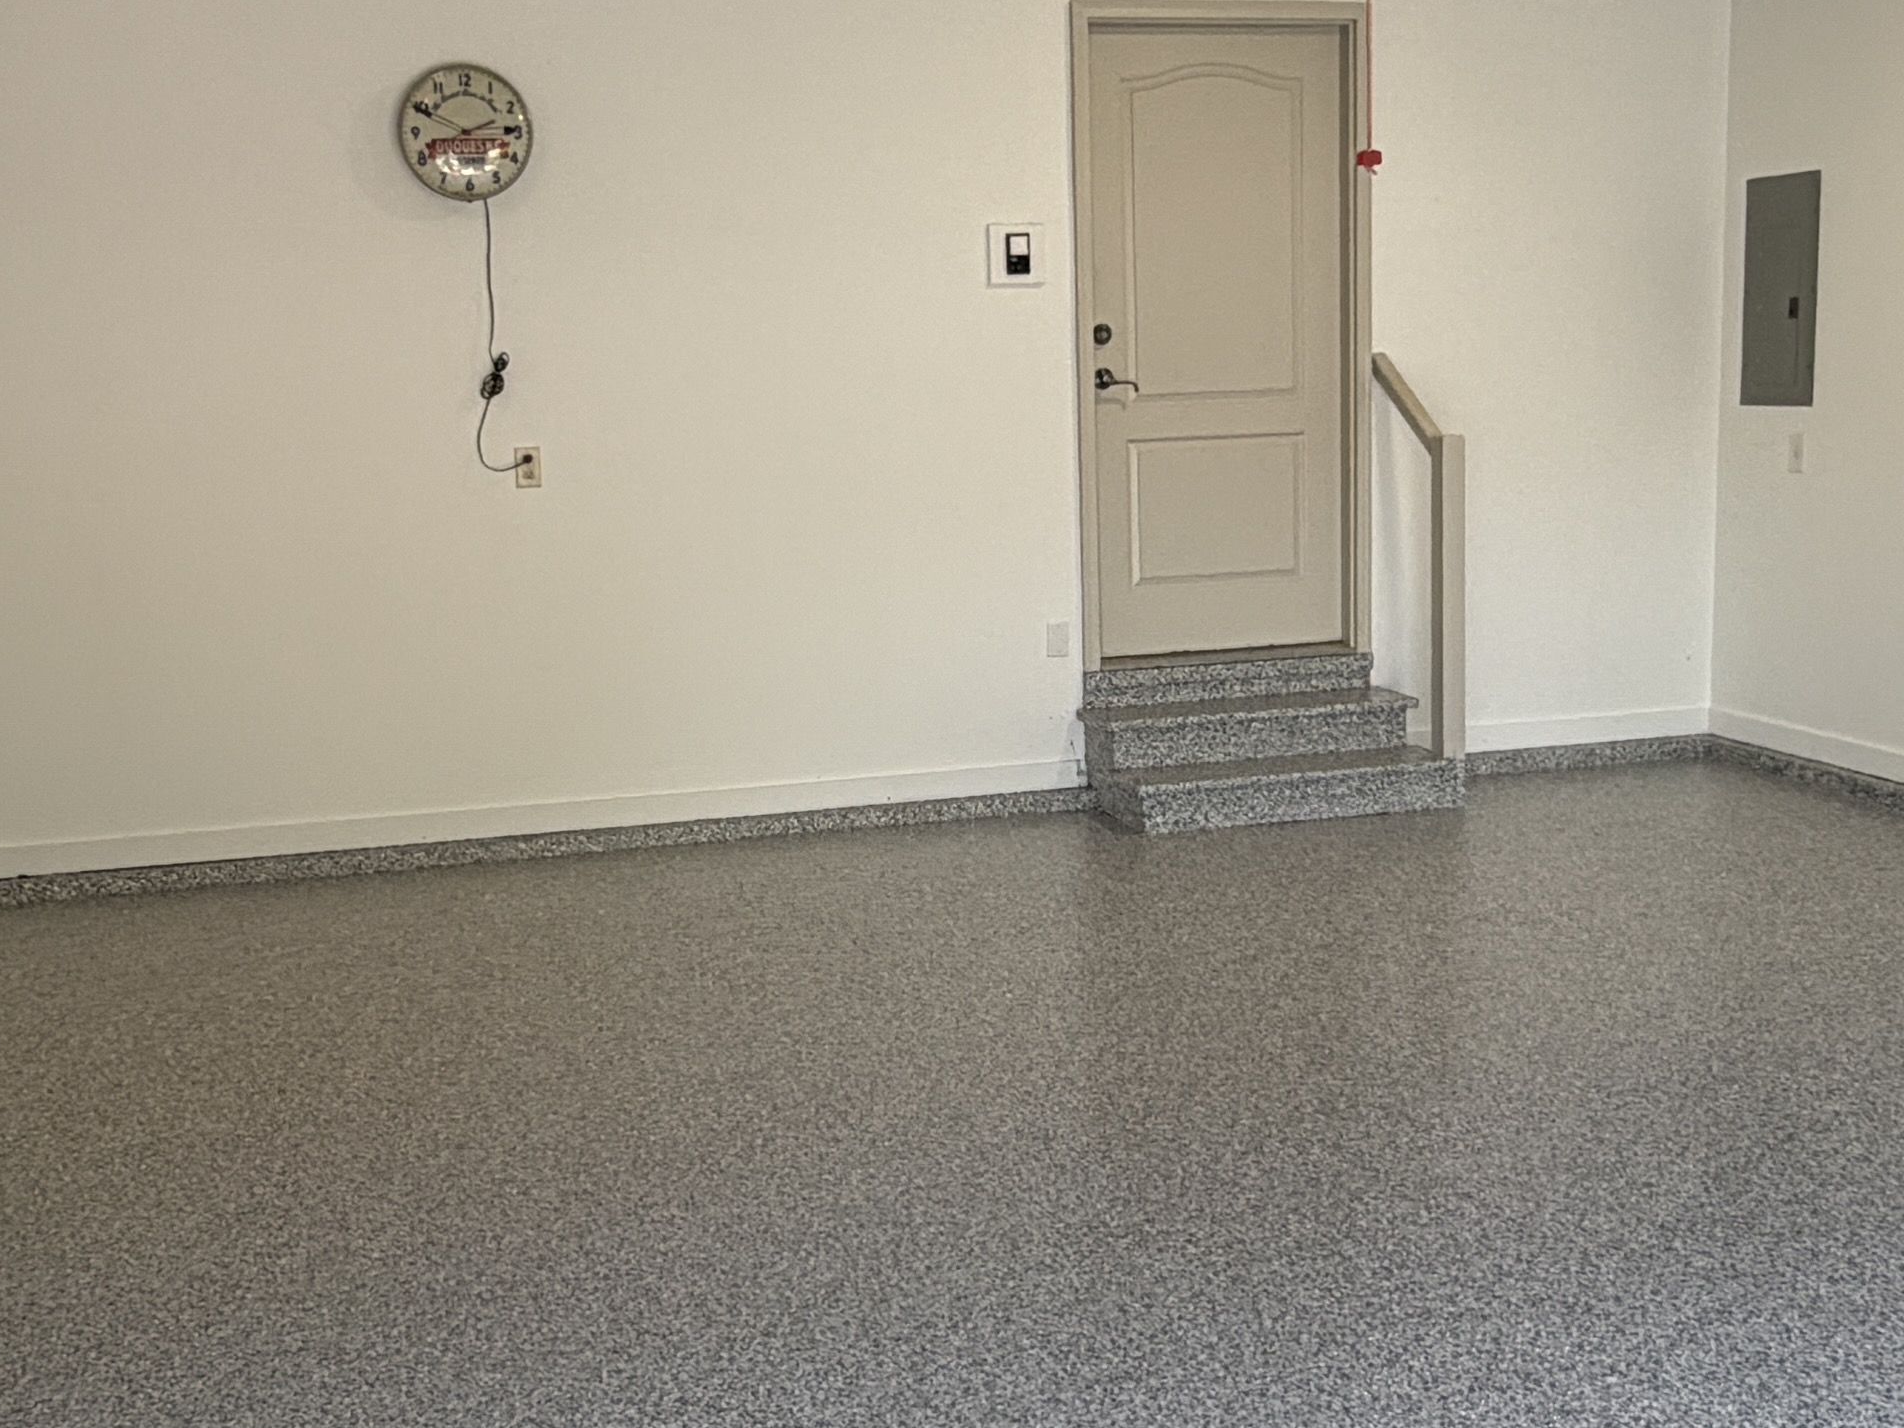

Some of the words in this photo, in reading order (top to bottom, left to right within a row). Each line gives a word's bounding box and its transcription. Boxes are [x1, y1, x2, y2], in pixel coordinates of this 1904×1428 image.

[432, 79, 444, 94] 11
[458, 73, 472, 87] 12
[488, 81, 493, 94] 1
[506, 100, 515, 114] 2
[411, 126, 421, 140] 9
[513, 125, 523, 139] 3
[417, 151, 427, 166] 8
[510, 152, 519, 165] 4
[440, 171, 448, 185] 7
[465, 177, 475, 191] 6
[492, 171, 501, 184] 5
